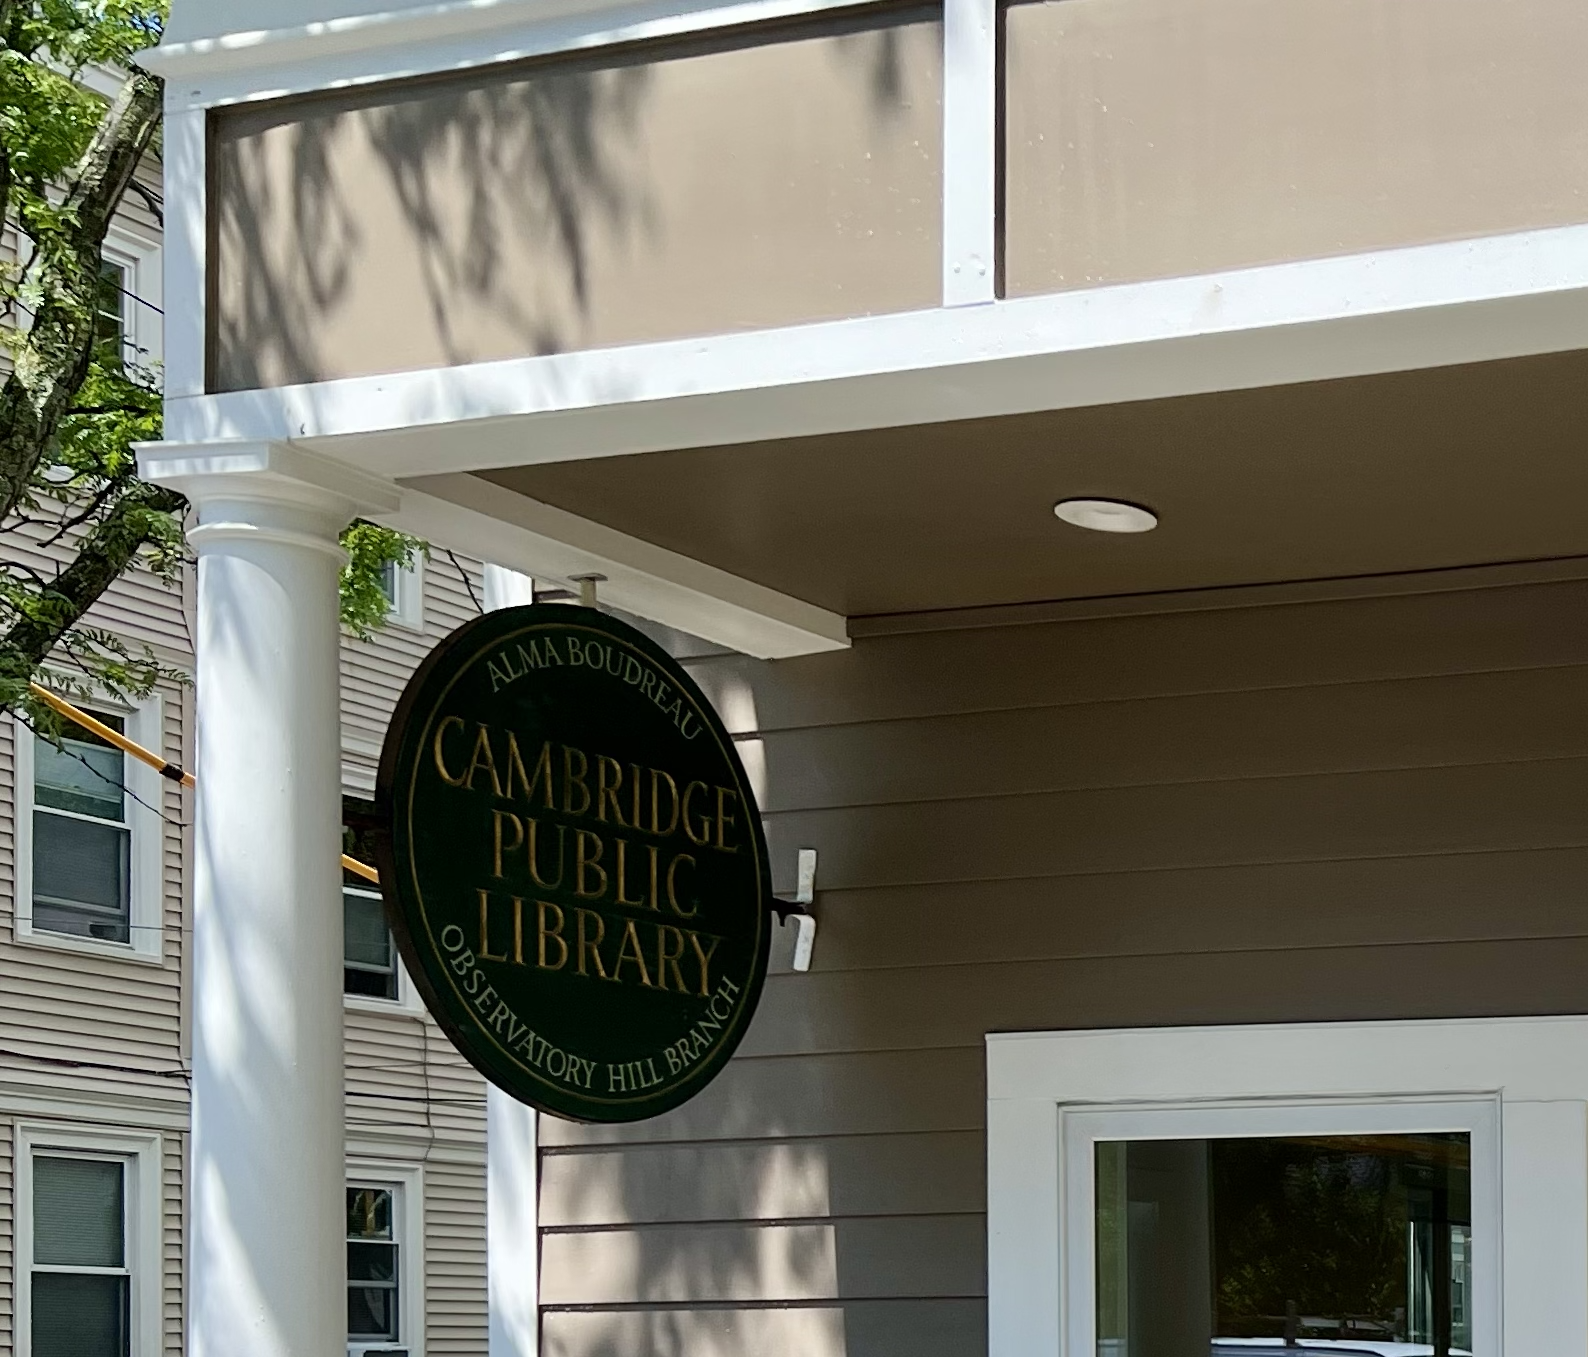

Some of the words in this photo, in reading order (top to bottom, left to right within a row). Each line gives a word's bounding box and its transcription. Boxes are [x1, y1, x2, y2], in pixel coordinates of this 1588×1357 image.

[486, 636, 563, 693] ALMA
[566, 636, 704, 740] BOUDREAU
[433, 715, 742, 853] CAMBRIDGE
[490, 807, 699, 920] PUBLIC
[475, 887, 722, 998] LIBRARY
[440, 923, 598, 1090] OBSERVATORY
[607, 1057, 664, 1092] HILL
[663, 975, 741, 1077] BRANCH
